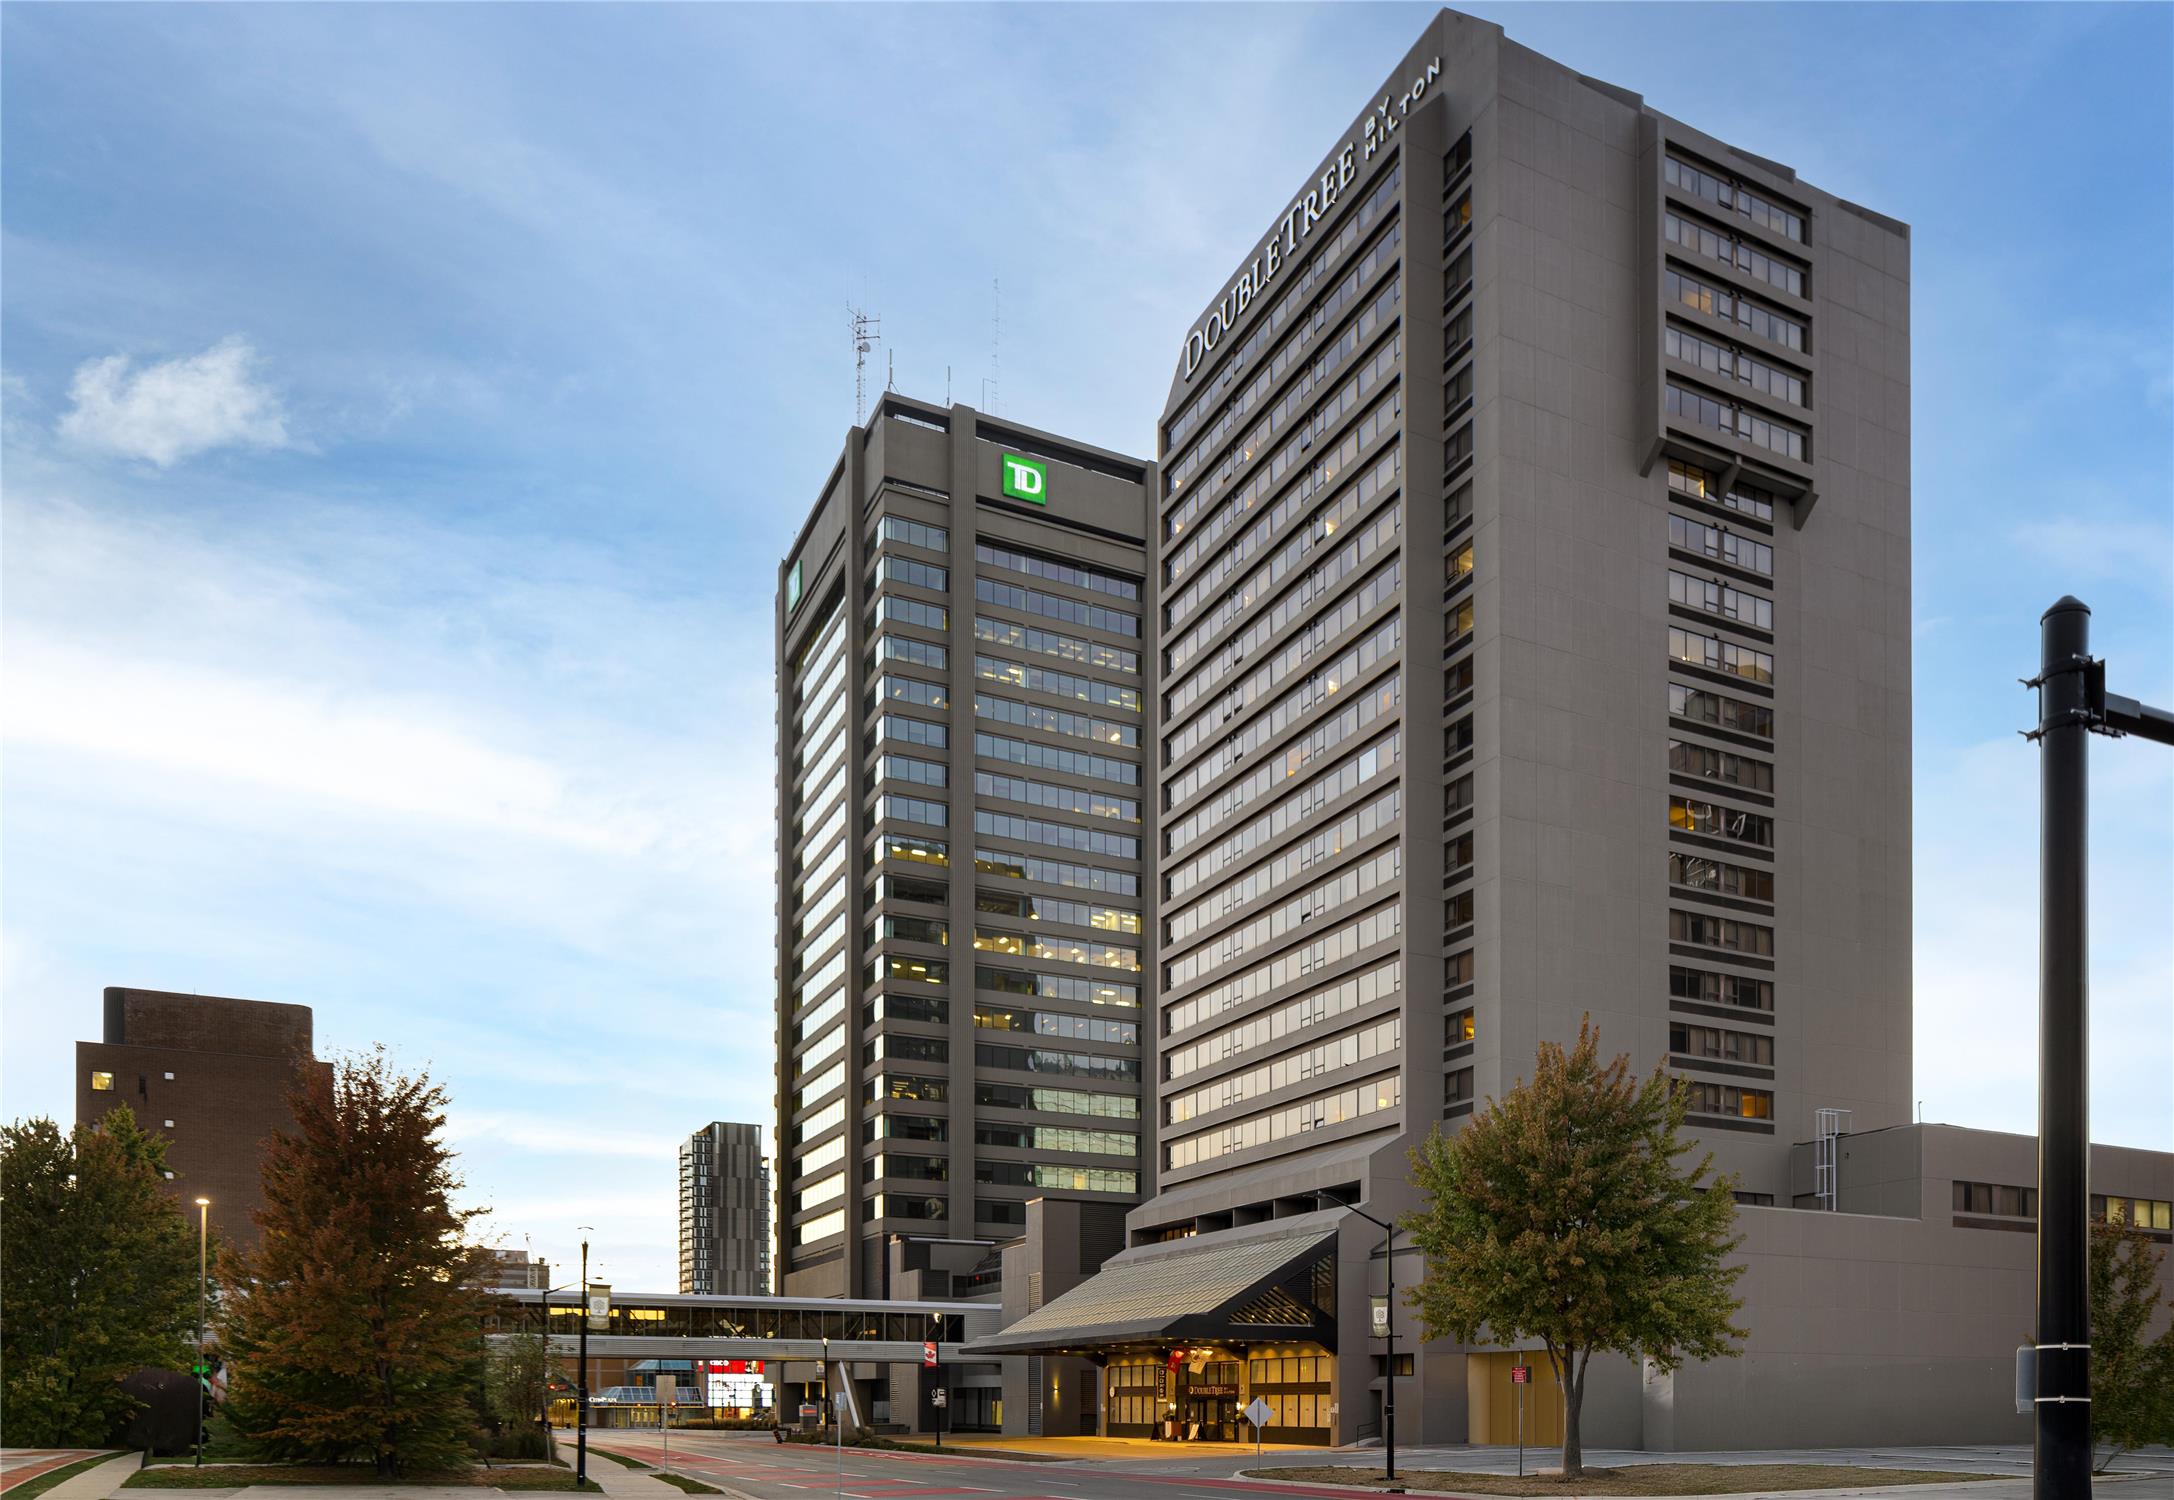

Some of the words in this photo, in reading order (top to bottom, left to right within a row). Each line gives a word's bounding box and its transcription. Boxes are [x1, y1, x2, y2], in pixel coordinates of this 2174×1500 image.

[1364, 56, 1441, 161] HILTON
[1364, 95, 1391, 140] BY
[1007, 460, 1042, 494] TD
